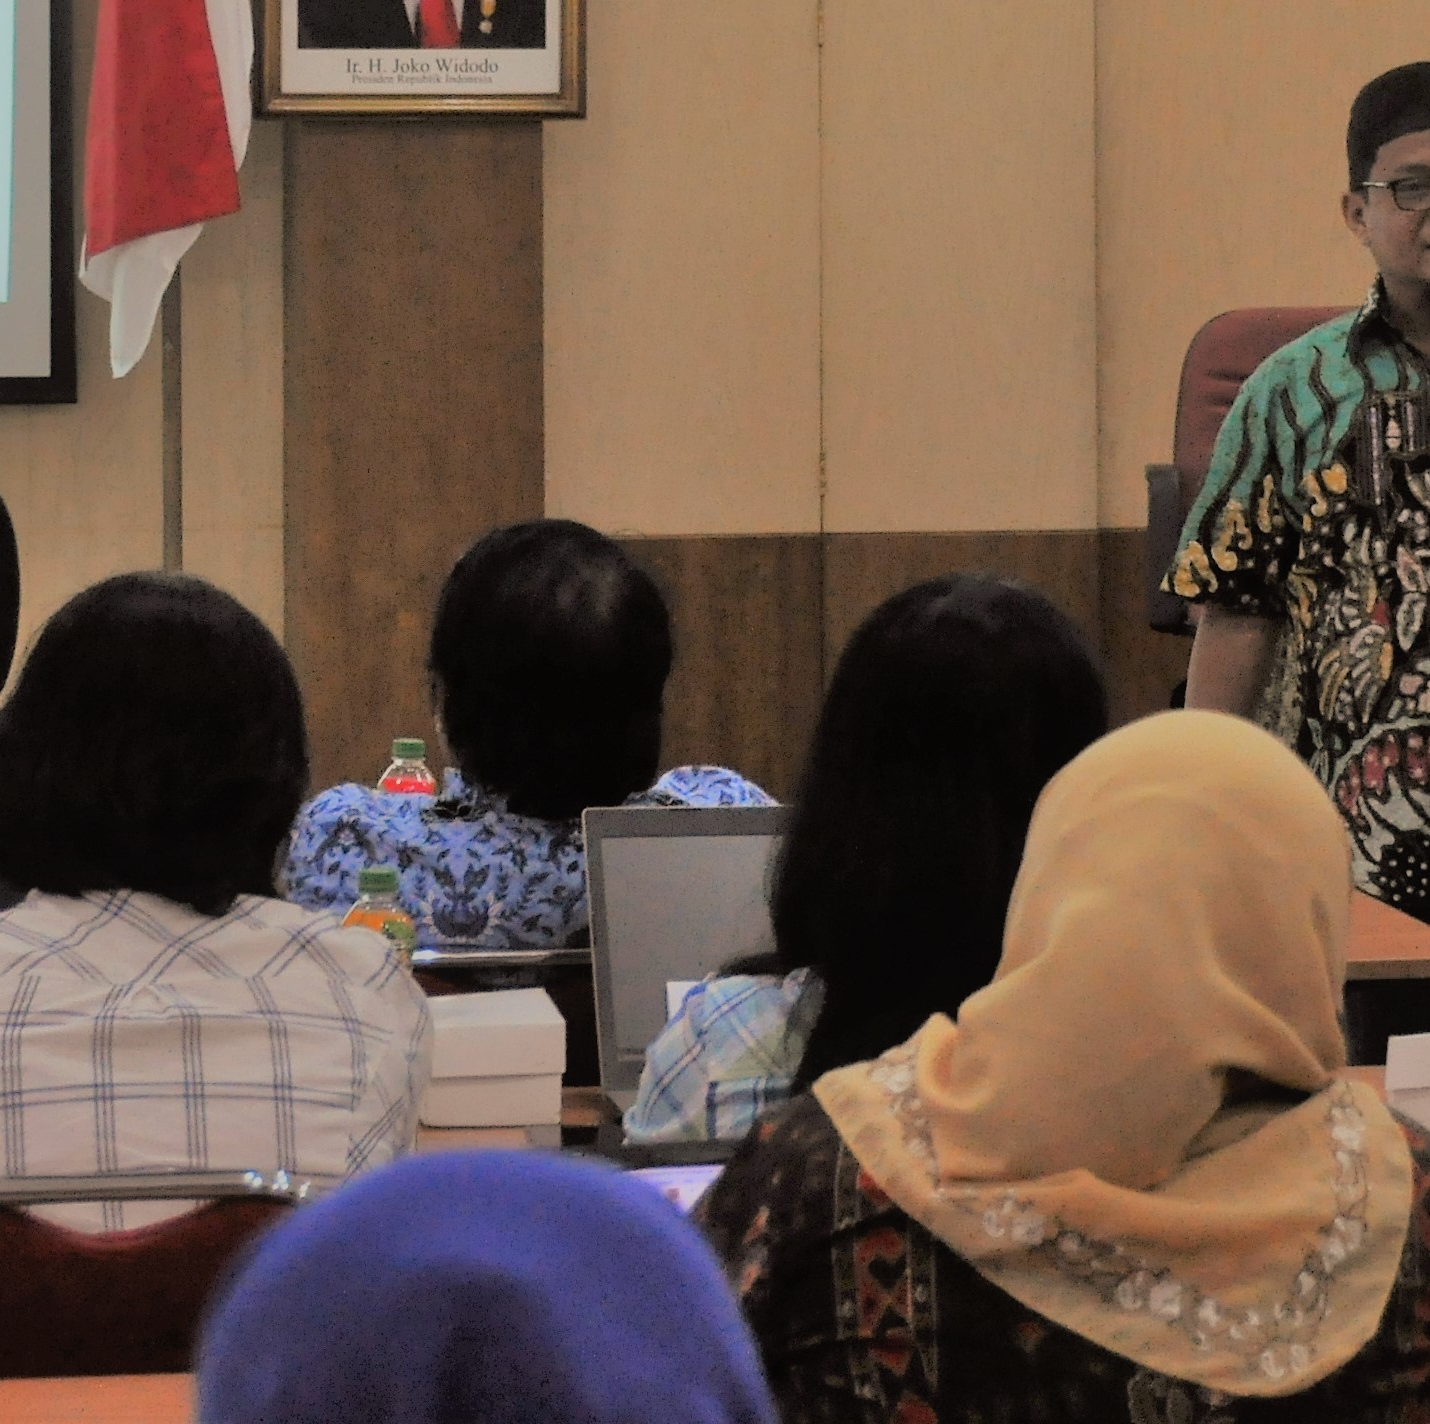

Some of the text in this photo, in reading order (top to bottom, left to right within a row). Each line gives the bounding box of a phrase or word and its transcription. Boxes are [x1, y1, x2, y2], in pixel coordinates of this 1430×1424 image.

[346, 58, 362, 74] Ir.
[392, 58, 430, 74] Joko
[435, 58, 499, 74] Widodo
